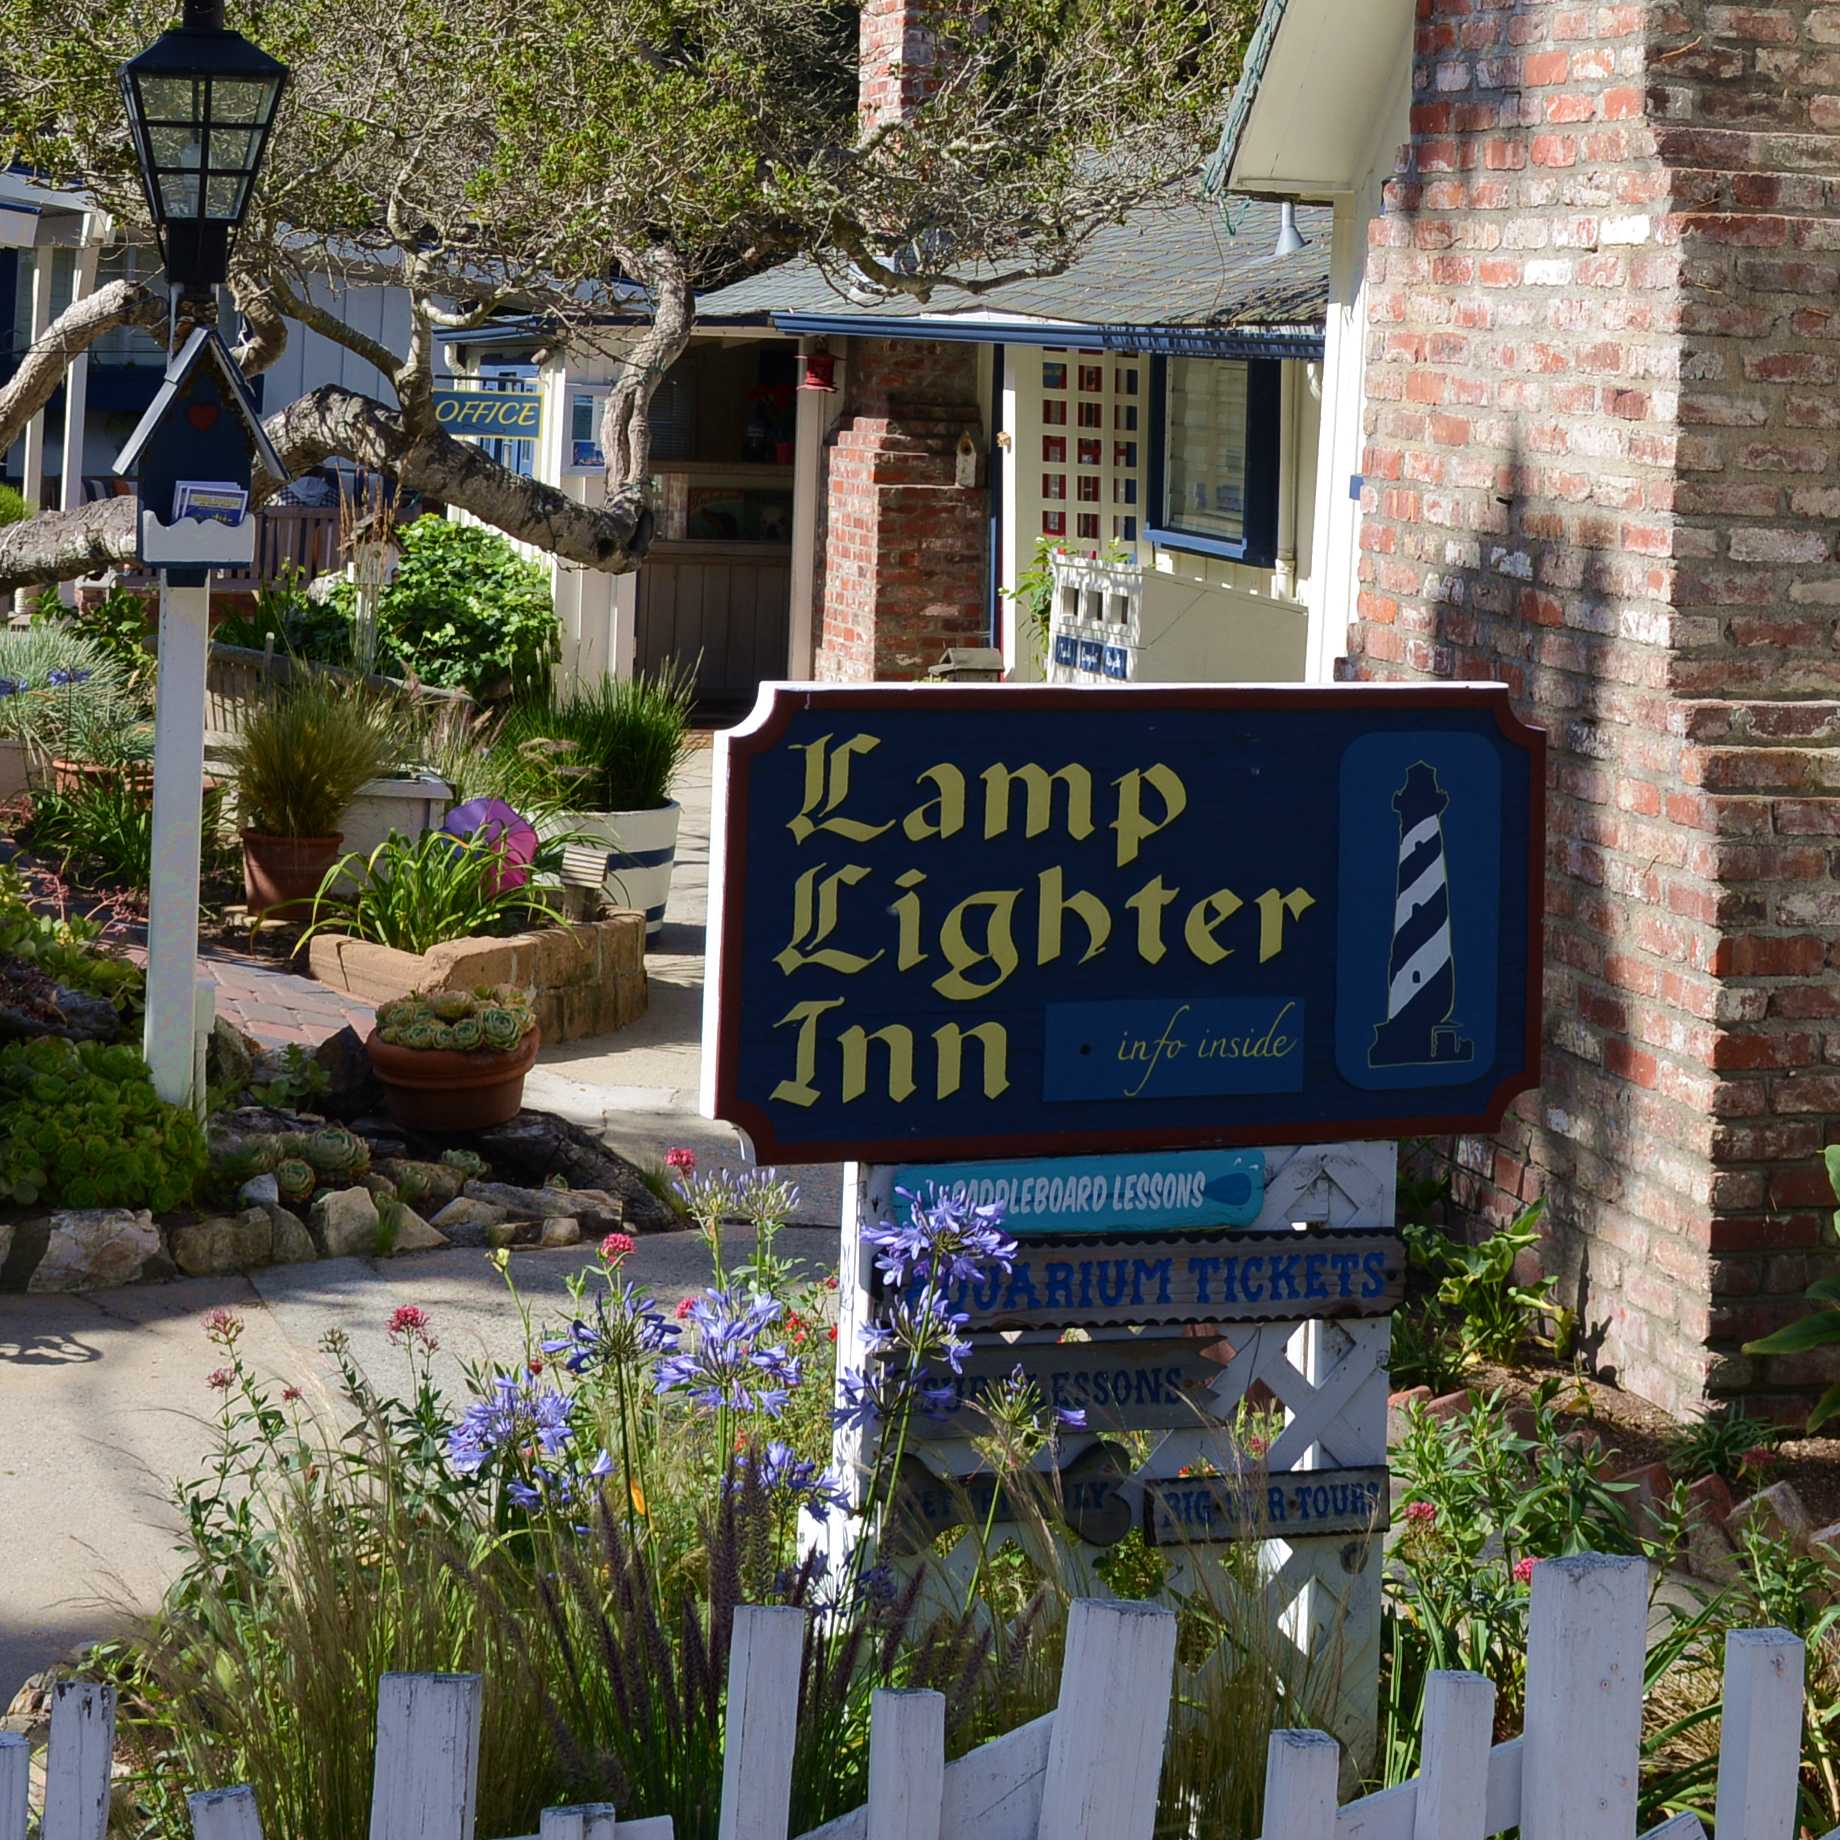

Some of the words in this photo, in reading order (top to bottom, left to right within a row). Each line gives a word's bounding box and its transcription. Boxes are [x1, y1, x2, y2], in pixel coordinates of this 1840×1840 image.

[434, 399, 539, 426] OFFICE
[784, 731, 1189, 869] Lamp
[770, 860, 1317, 1002] Lighter
[768, 995, 1011, 1109] Inn
[1117, 1003, 1188, 1098] info
[1197, 1001, 1298, 1061] inside
[1112, 1170, 1207, 1211] LESSONS
[1187, 1251, 1386, 1304] TICKETS
